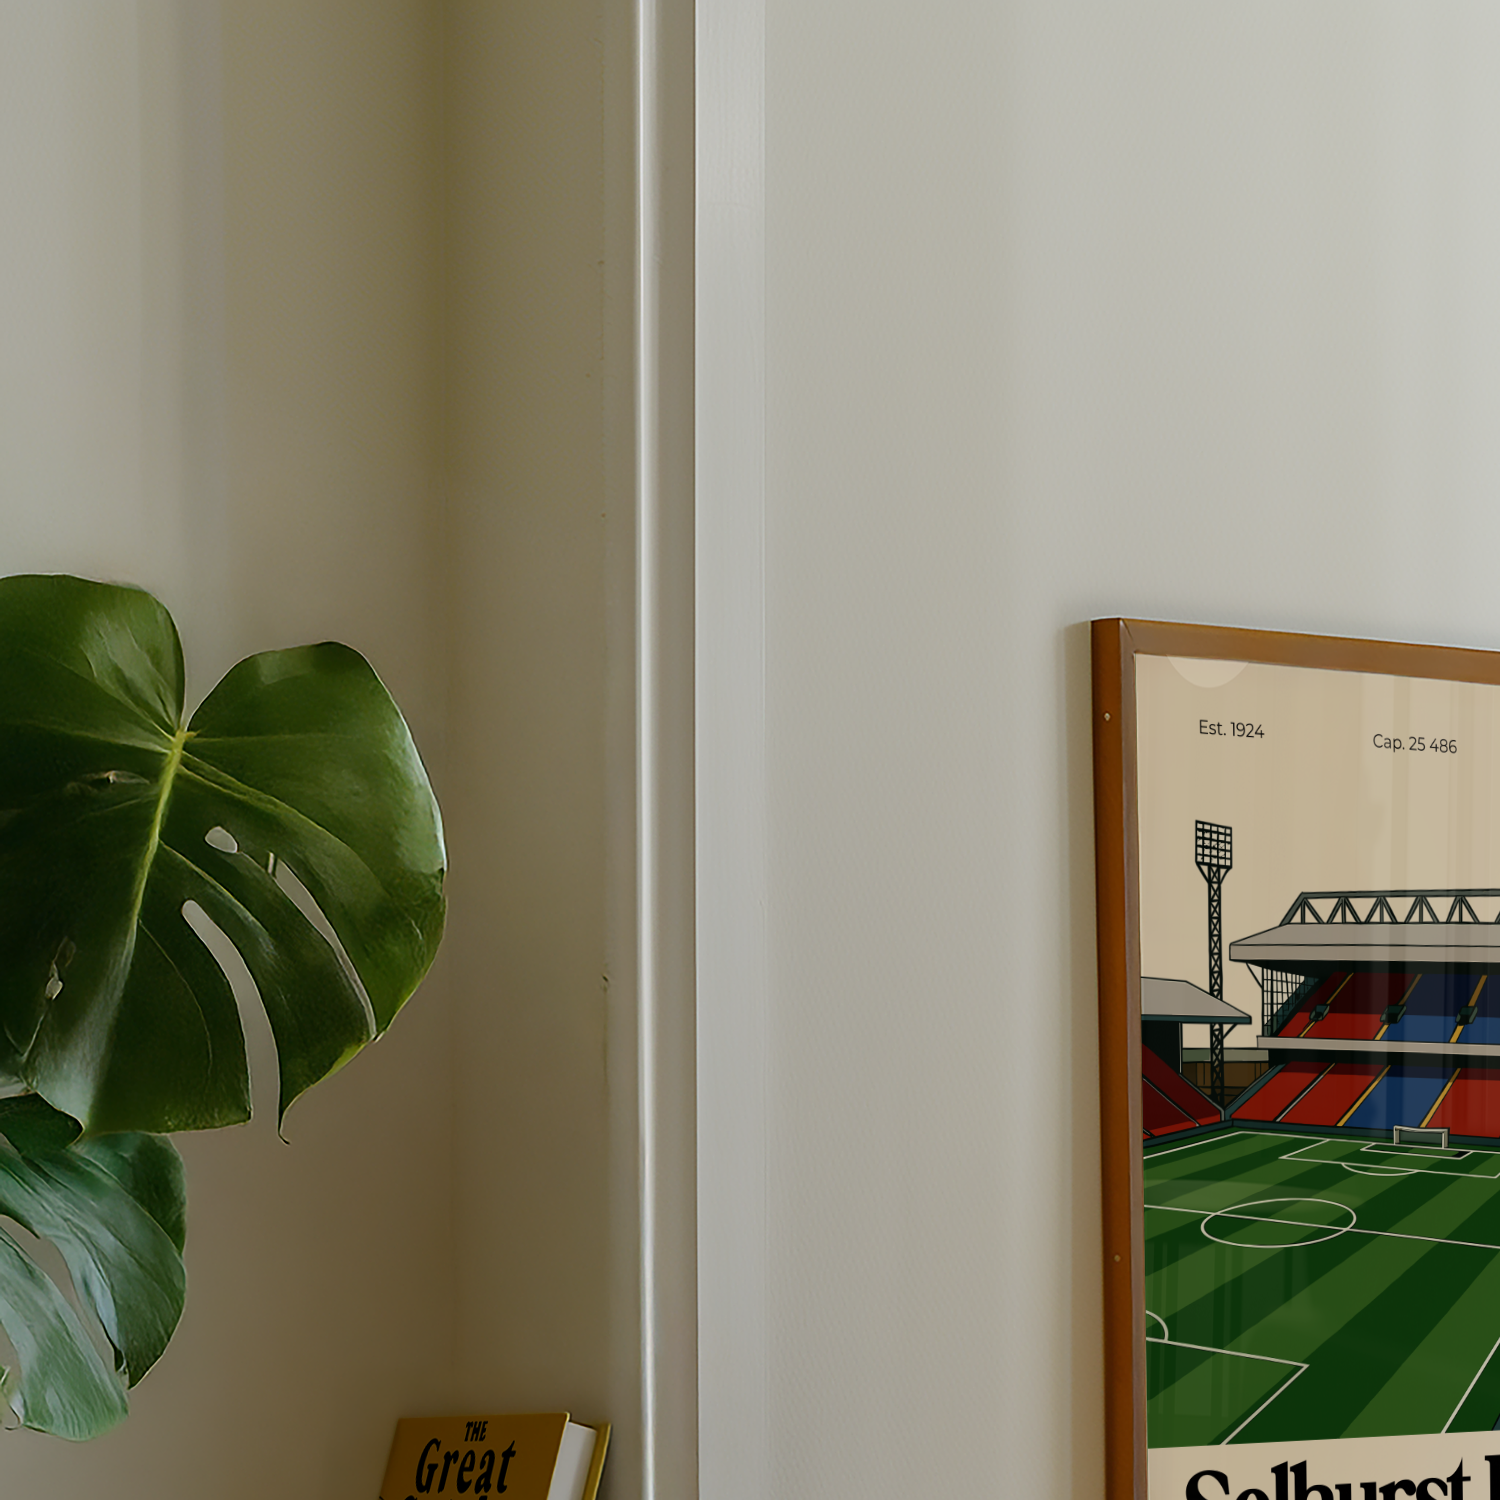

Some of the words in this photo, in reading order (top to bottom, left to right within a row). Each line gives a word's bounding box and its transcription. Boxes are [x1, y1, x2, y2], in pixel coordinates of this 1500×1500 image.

[1199, 719, 1227, 736] Est.
[1230, 722, 1265, 738] 1924
[1373, 734, 1406, 752] Cap.
[1408, 736, 1426, 751] 25
[1429, 738, 1458, 753] 486
[464, 1420, 489, 1442] THE
[415, 1438, 517, 1494] Great
